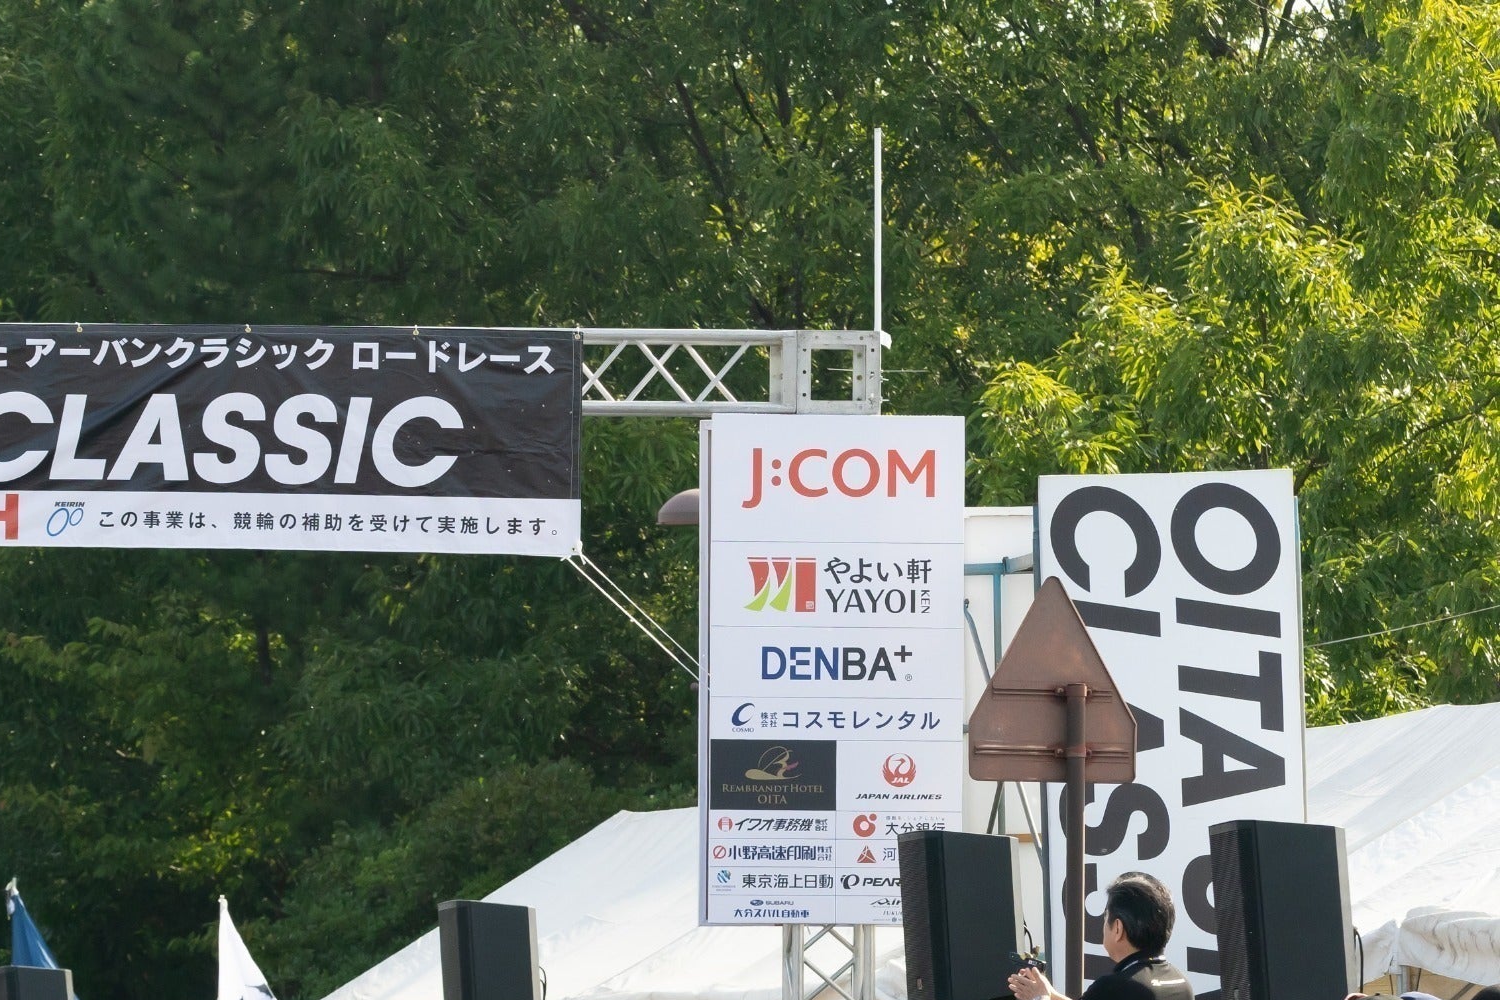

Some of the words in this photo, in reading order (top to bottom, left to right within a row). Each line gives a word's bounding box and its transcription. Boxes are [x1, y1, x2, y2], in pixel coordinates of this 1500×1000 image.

[25, 336, 336, 371] アーバンクラシック
[351, 343, 556, 376] ロードレース
[742, 448, 936, 509] J:COM
[99, 510, 560, 536] この事業は、競輪の補助を受けて実施します。
[824, 557, 932, 585] やよい軒
[825, 588, 916, 614] YAYOI
[920, 590, 931, 614] KEN
[1170, 482, 1286, 807] OITA
[783, 711, 941, 730] コスモレンタル
[757, 795, 787, 805] OITA
[735, 818, 814, 831] イワオ事務機
[728, 845, 817, 860] 小野高速印刷
[742, 874, 834, 889] 東京海上日動
[863, 877, 901, 887] PEAR
